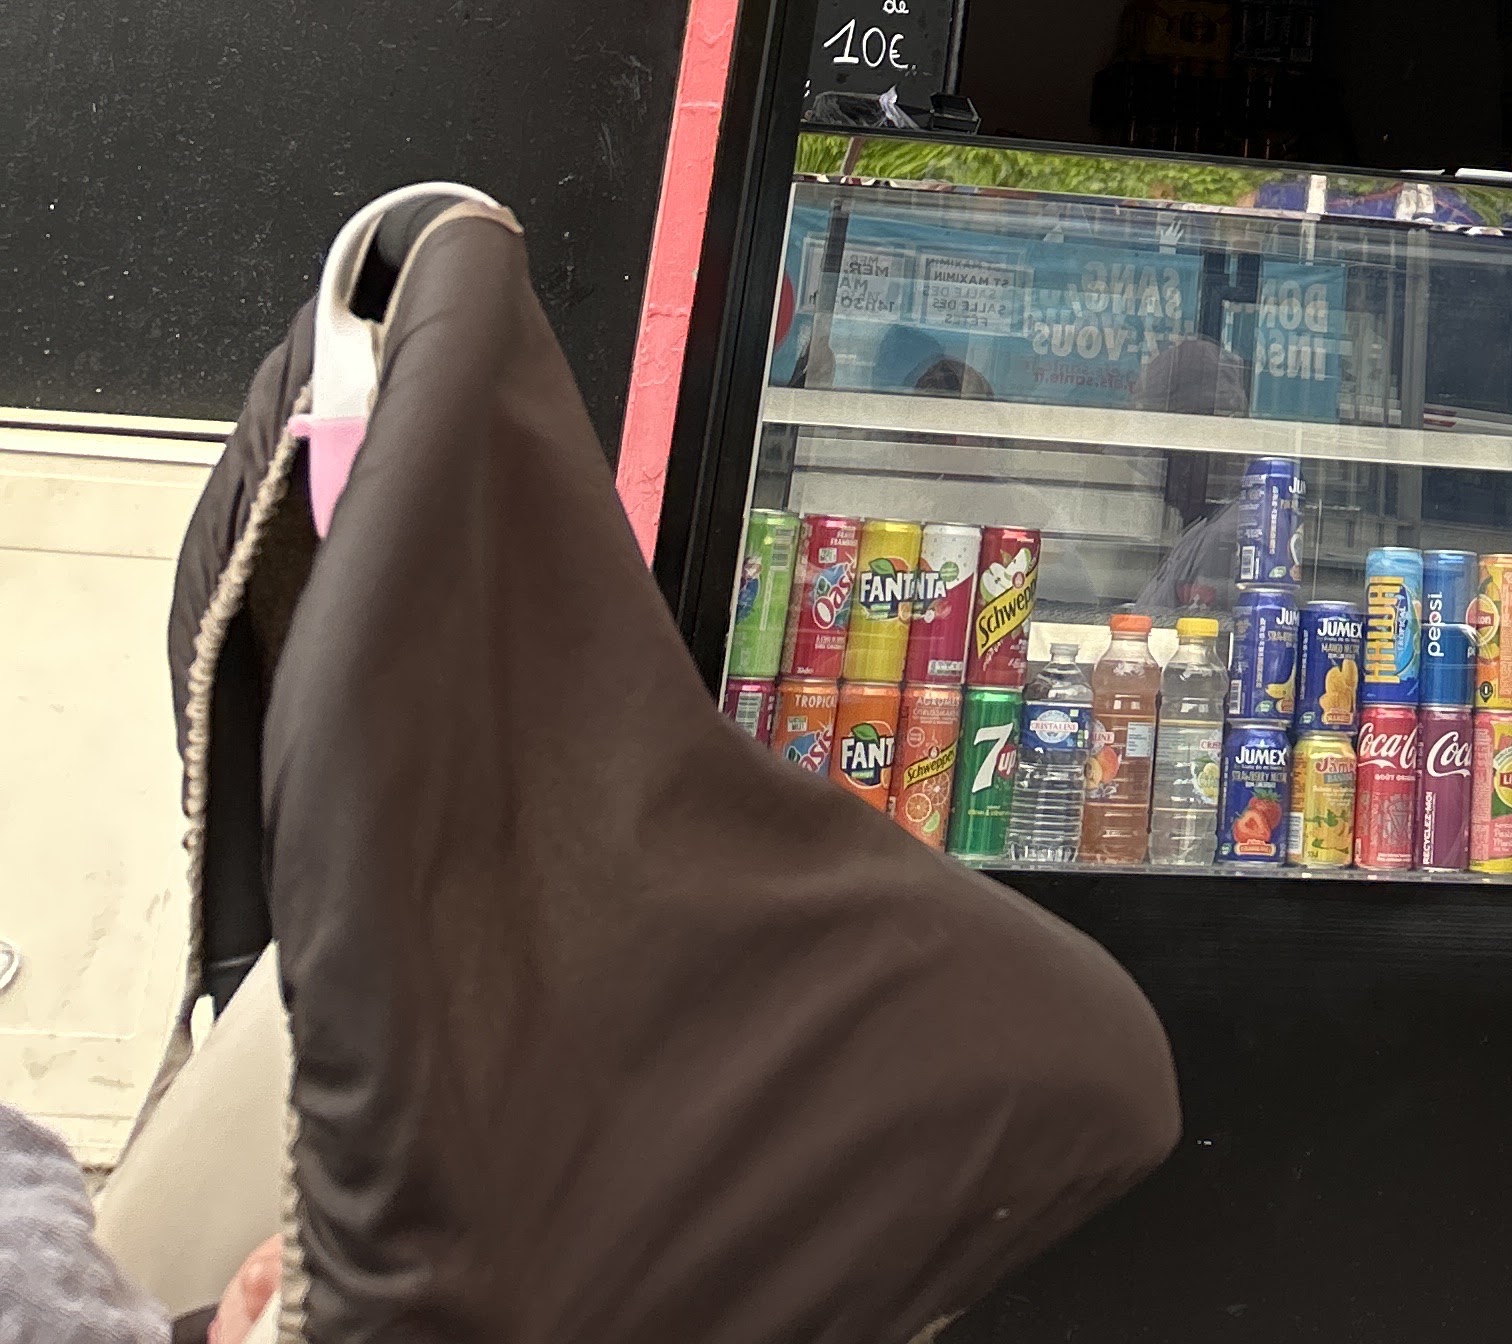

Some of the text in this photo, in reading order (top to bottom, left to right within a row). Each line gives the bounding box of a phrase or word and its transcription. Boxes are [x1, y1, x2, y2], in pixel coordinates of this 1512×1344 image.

[823, 18, 910, 70] 10€
[1275, 607, 1300, 625] JUM
[1316, 617, 1363, 639] JUMEX
[1364, 575, 1404, 684] HAWAI
[1427, 591, 1445, 658] pepsi
[841, 736, 896, 770] FANT
[1235, 745, 1287, 766] JUMEX
